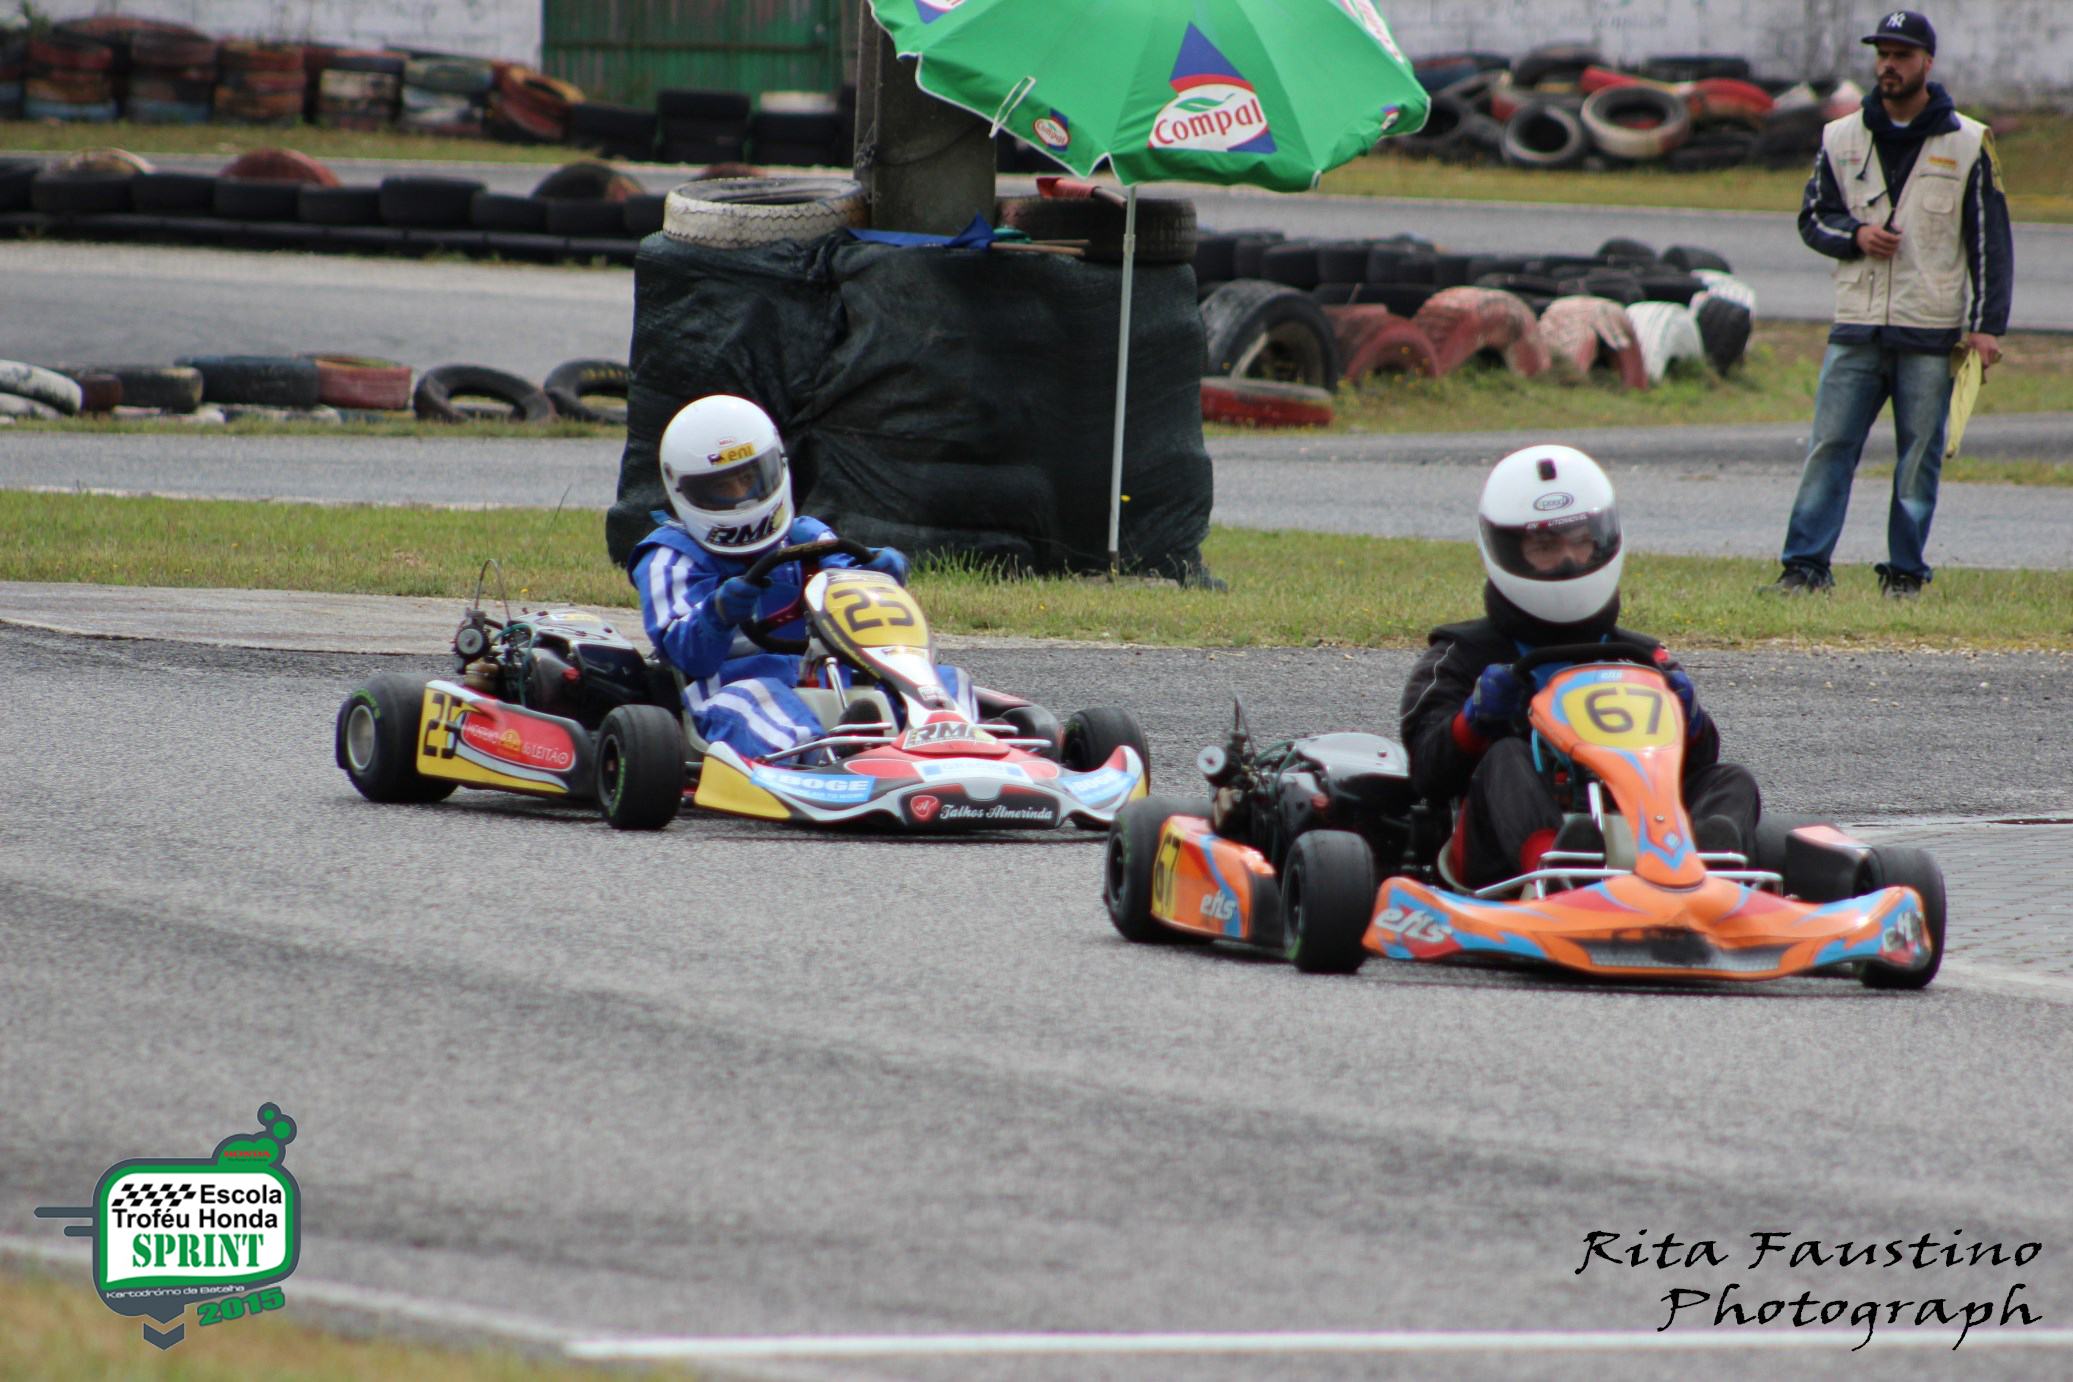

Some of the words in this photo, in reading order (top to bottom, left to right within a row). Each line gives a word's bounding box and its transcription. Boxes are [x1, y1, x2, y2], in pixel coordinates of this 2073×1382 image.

[1036, 119, 1066, 145] Compal
[1154, 98, 1263, 144] Compal
[728, 444, 754, 461] eni
[831, 586, 915, 633] 25
[1584, 686, 1664, 735] 67
[532, 743, 569, 765] LEITÃO
[778, 774, 870, 791] BOGE
[940, 804, 984, 819] Talhos
[986, 804, 1053, 820] Almerinda
